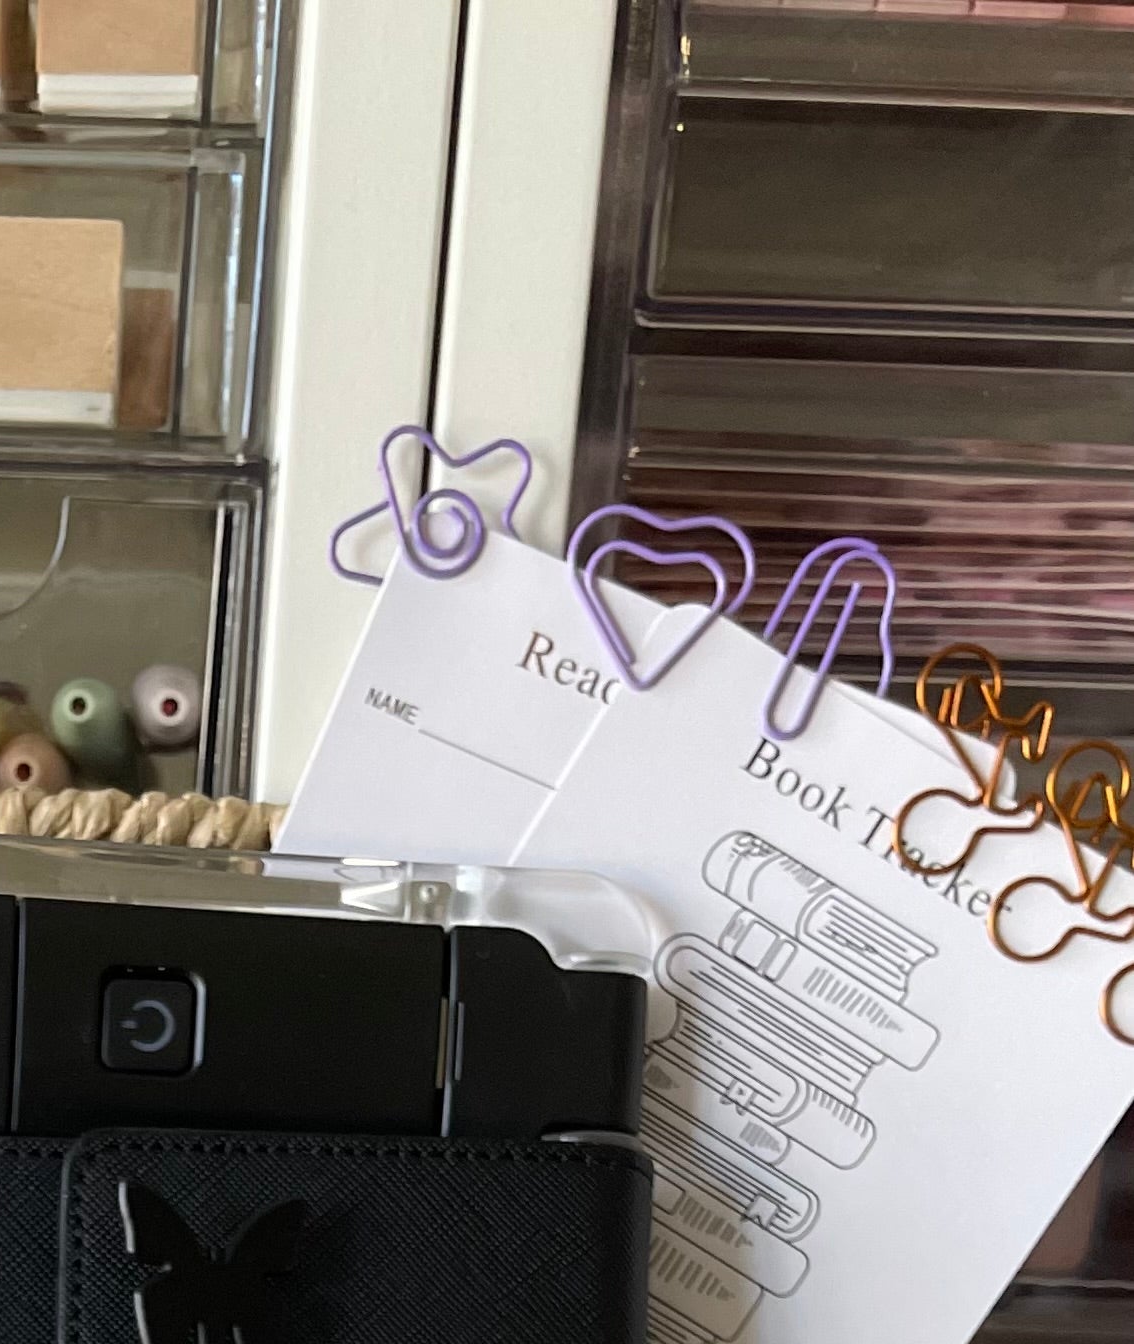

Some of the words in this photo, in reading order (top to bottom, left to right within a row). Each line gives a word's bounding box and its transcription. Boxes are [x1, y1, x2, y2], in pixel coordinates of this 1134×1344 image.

[363, 687, 419, 726] NAME
[739, 736, 853, 832] Book
[857, 806, 1013, 917] Tracke
